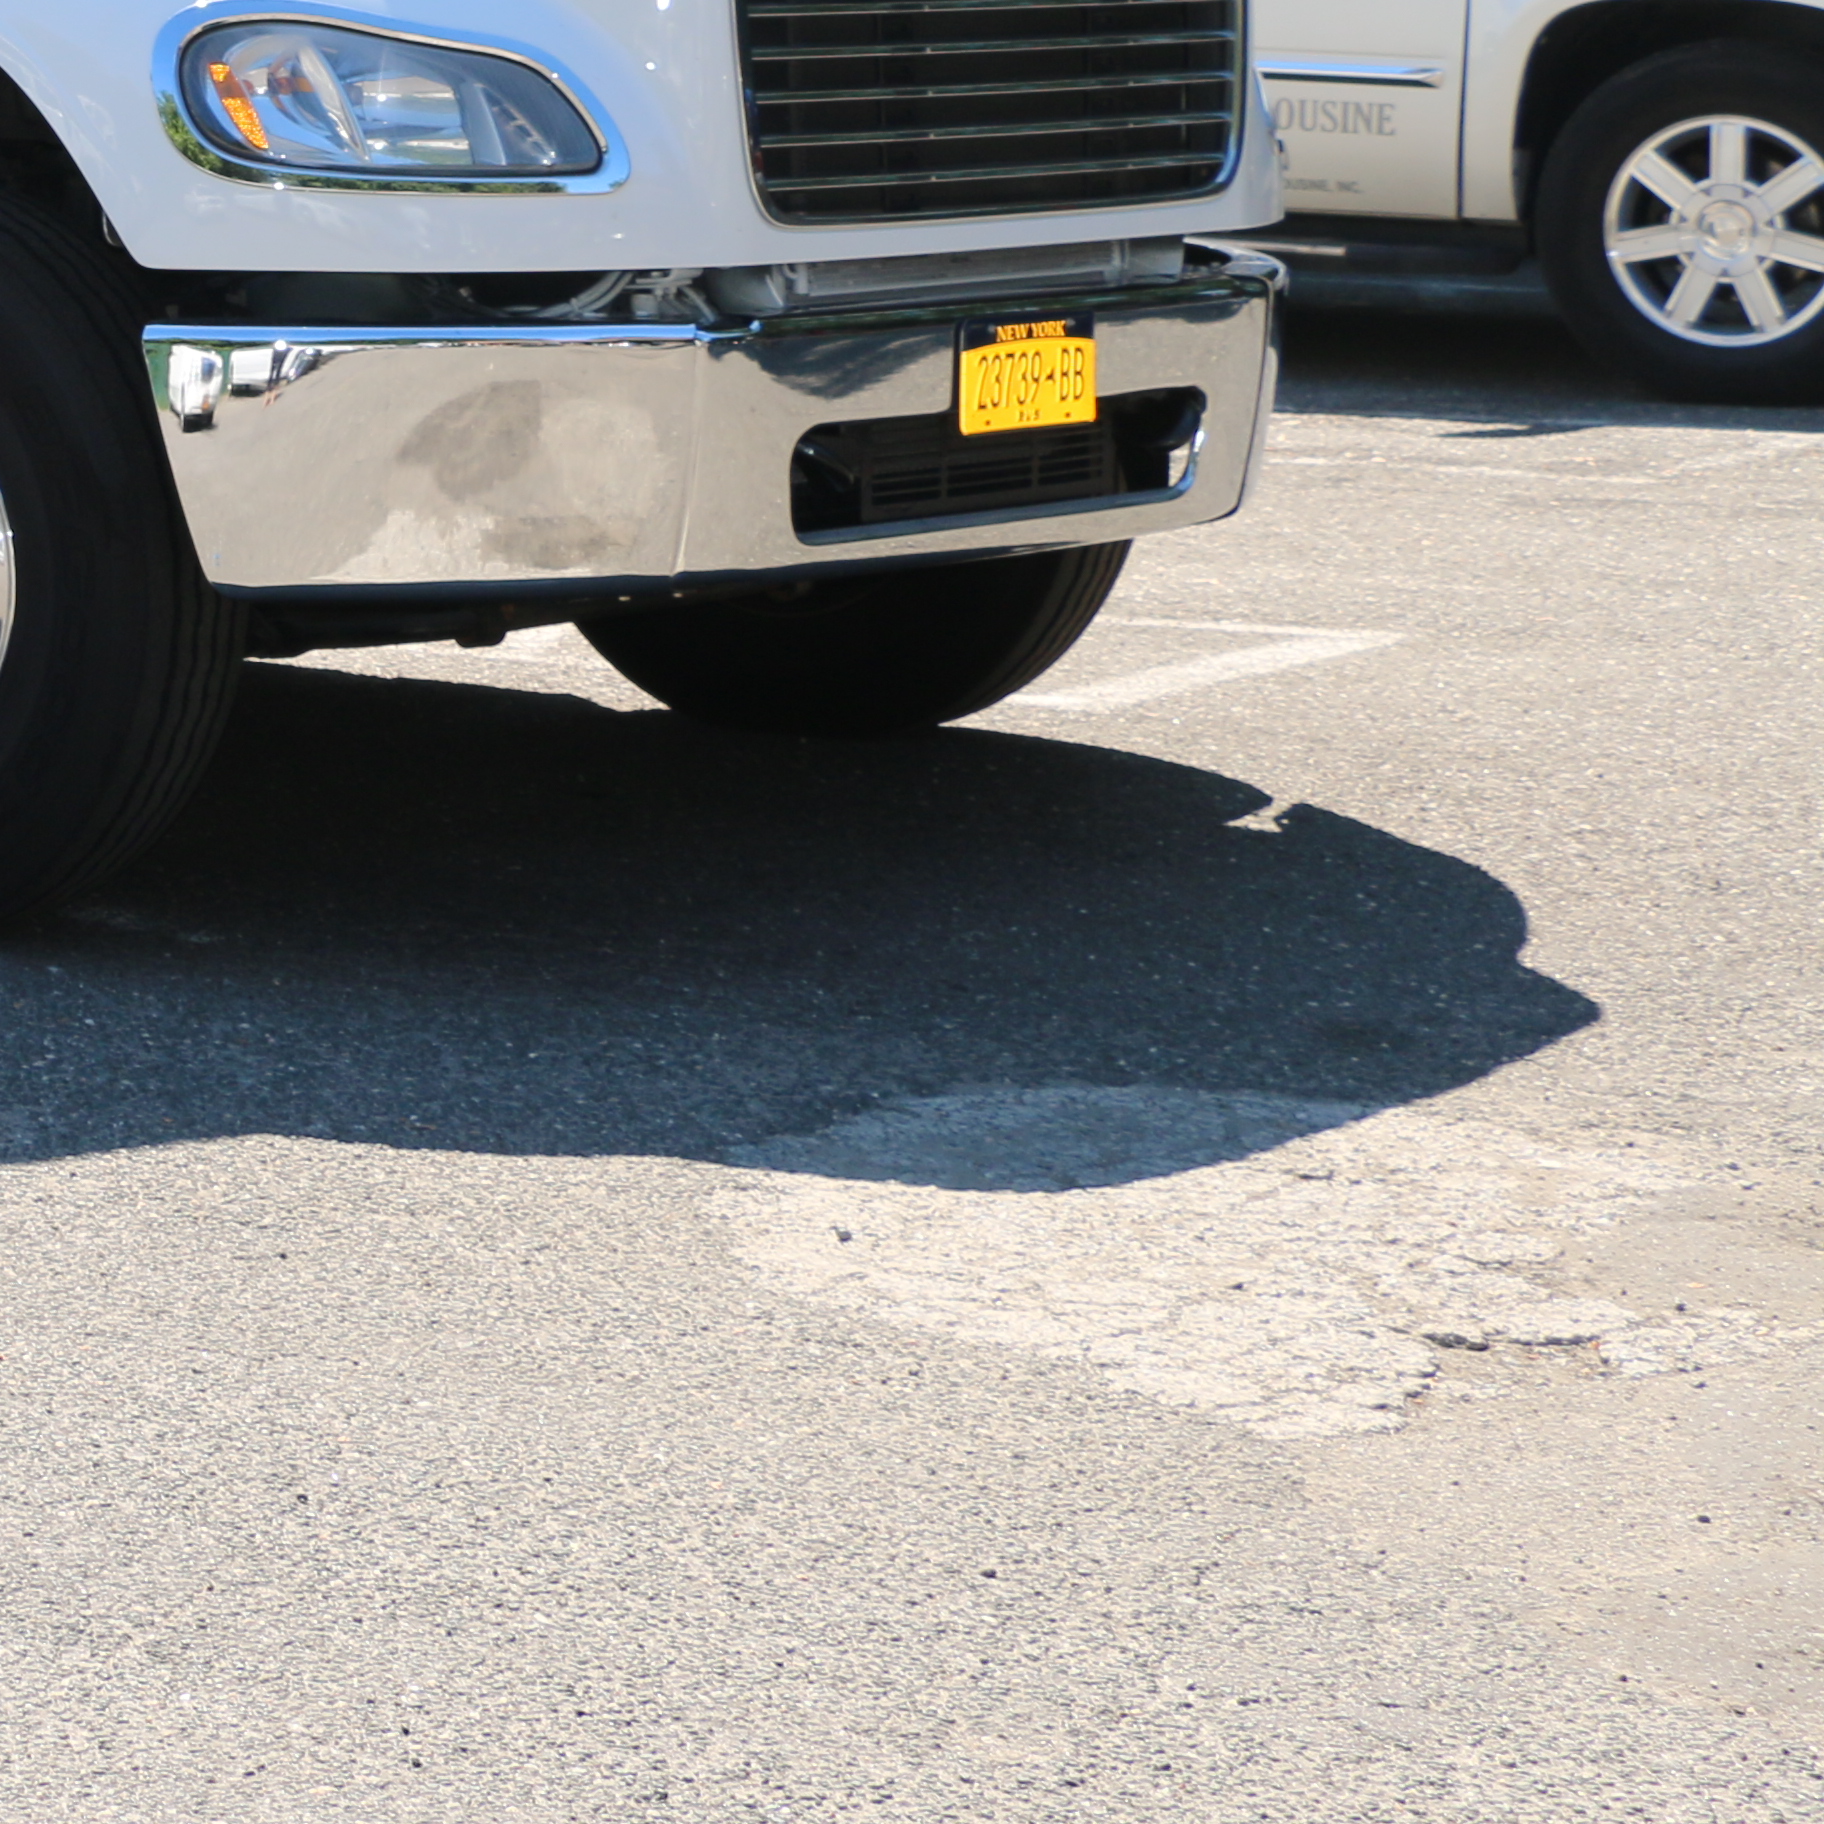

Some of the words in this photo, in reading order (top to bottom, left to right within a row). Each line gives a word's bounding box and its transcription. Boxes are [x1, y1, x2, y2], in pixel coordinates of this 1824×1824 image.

[1273, 97, 1398, 136] OUSINE
[996, 325, 1029, 342] NEW
[1029, 319, 1067, 339] YORK
